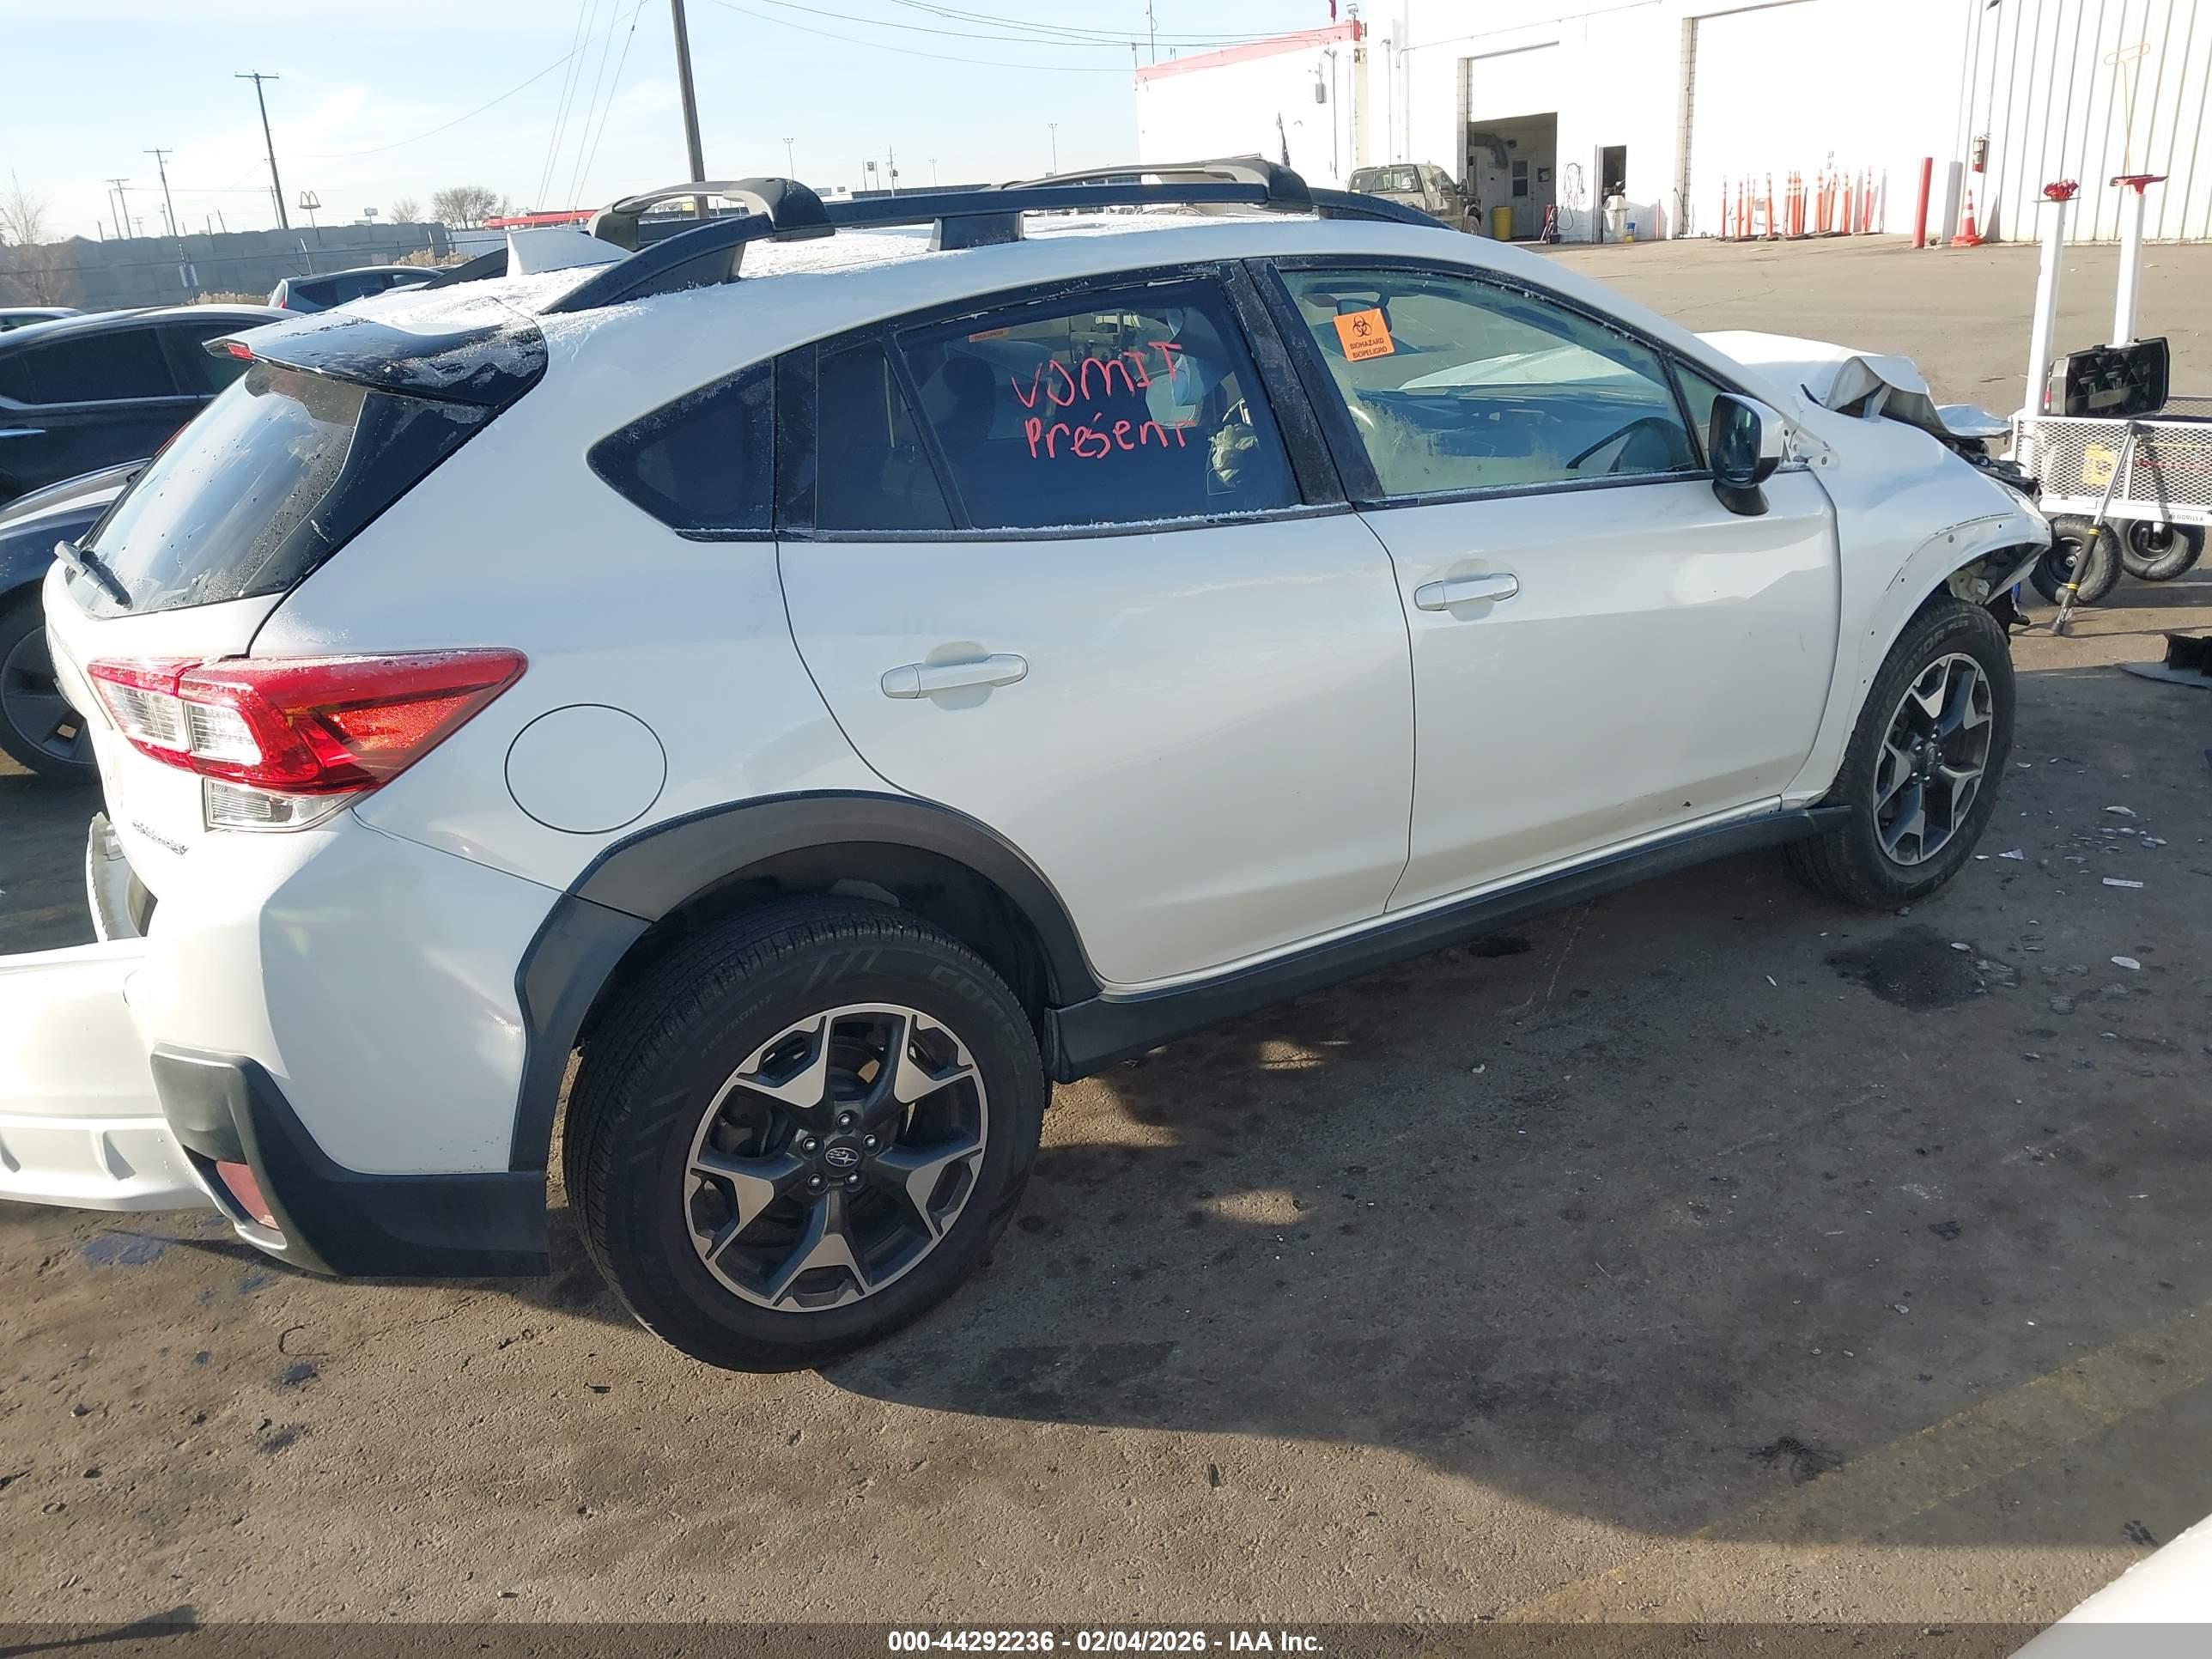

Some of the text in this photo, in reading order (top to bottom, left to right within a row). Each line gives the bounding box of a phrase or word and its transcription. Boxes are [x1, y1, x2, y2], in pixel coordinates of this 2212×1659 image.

[1349, 337, 1384, 350] BIOHAZARD
[1352, 346, 1388, 359] BIOPELIGRO
[1011, 341, 1182, 409] VOMIT
[2176, 514, 2204, 522] GORILLA
